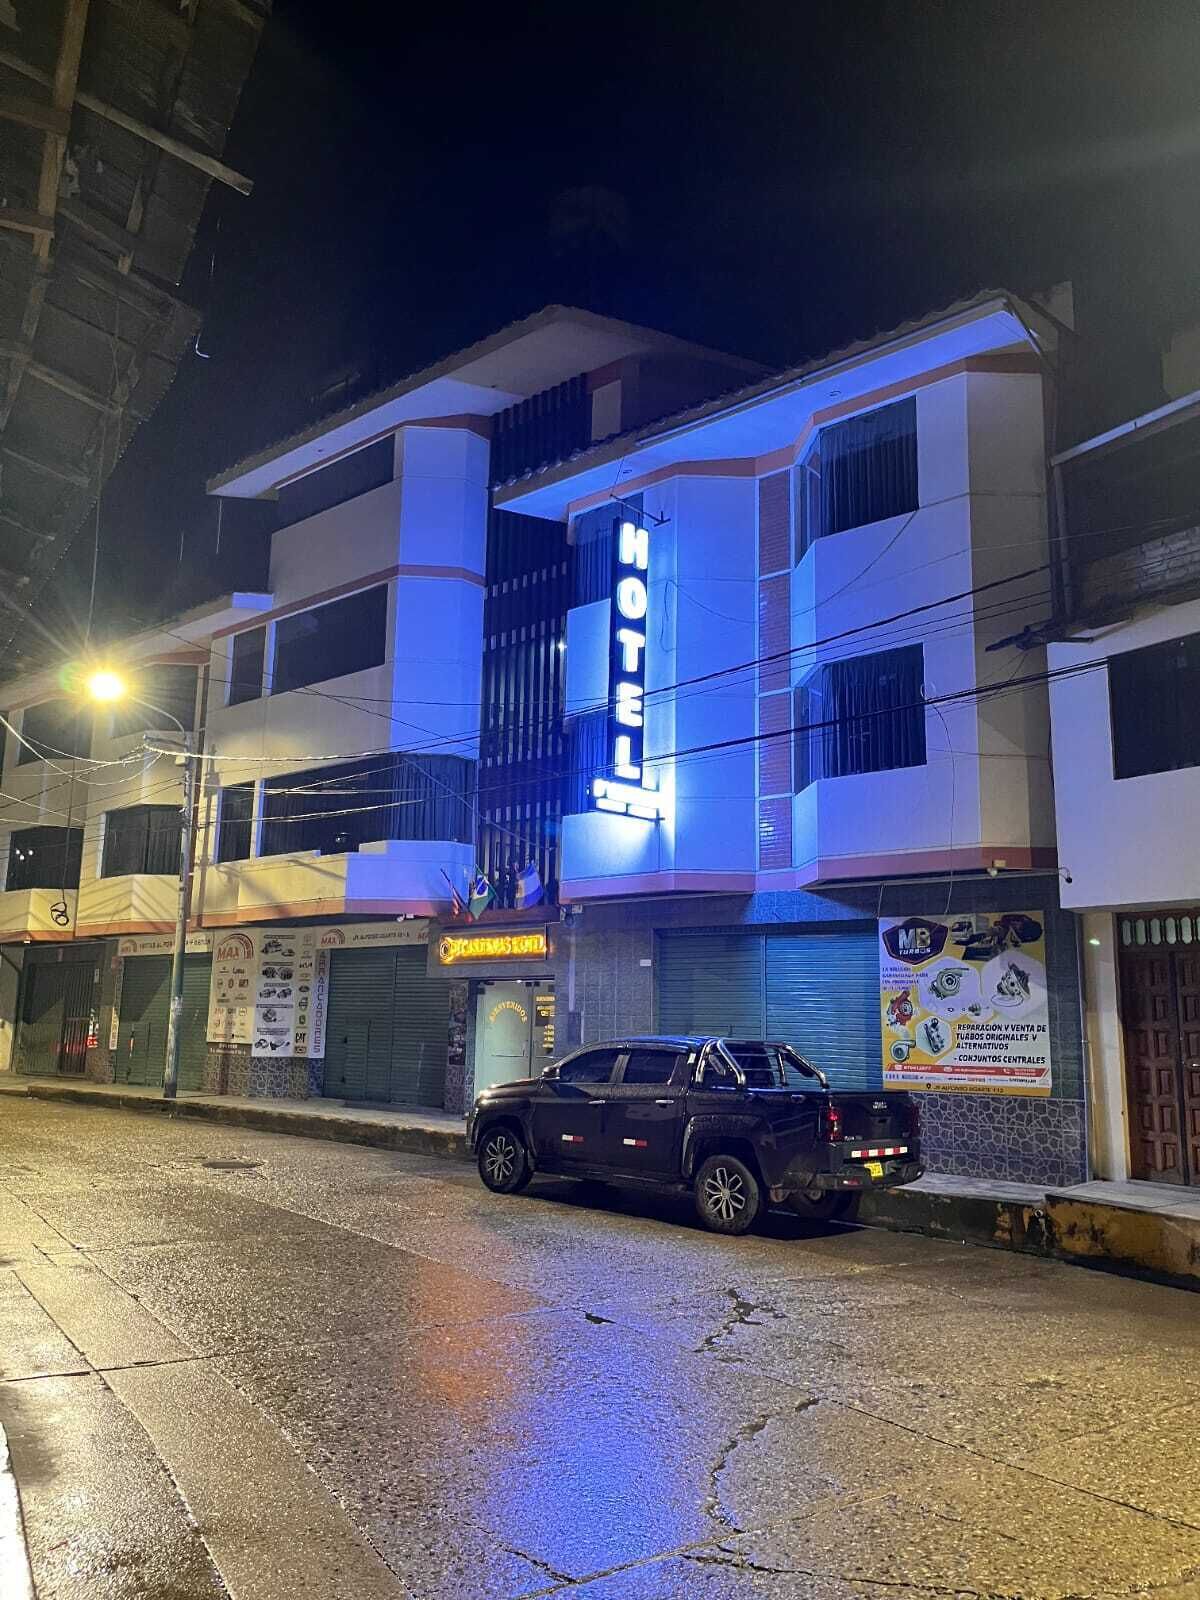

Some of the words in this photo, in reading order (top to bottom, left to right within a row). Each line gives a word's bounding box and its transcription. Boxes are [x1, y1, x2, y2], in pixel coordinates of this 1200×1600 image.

[615, 522, 648, 779] HOTEL
[898, 927, 930, 949] MB
[217, 947, 240, 960] MAX
[899, 947, 931, 955] TURBOS
[489, 1000, 528, 1024] BIENVENIDOS
[1010, 1024, 1035, 1033] VENTA
[1036, 1025, 1047, 1033] DE
[956, 1033, 985, 1041] TURBOS
[985, 1033, 1029, 1041] ORIGINALES
[956, 1042, 1009, 1050] ALTERNATIVOS
[958, 1054, 1001, 1063] CONJUNTOS
[1003, 1055, 1046, 1065] CENTRALES
